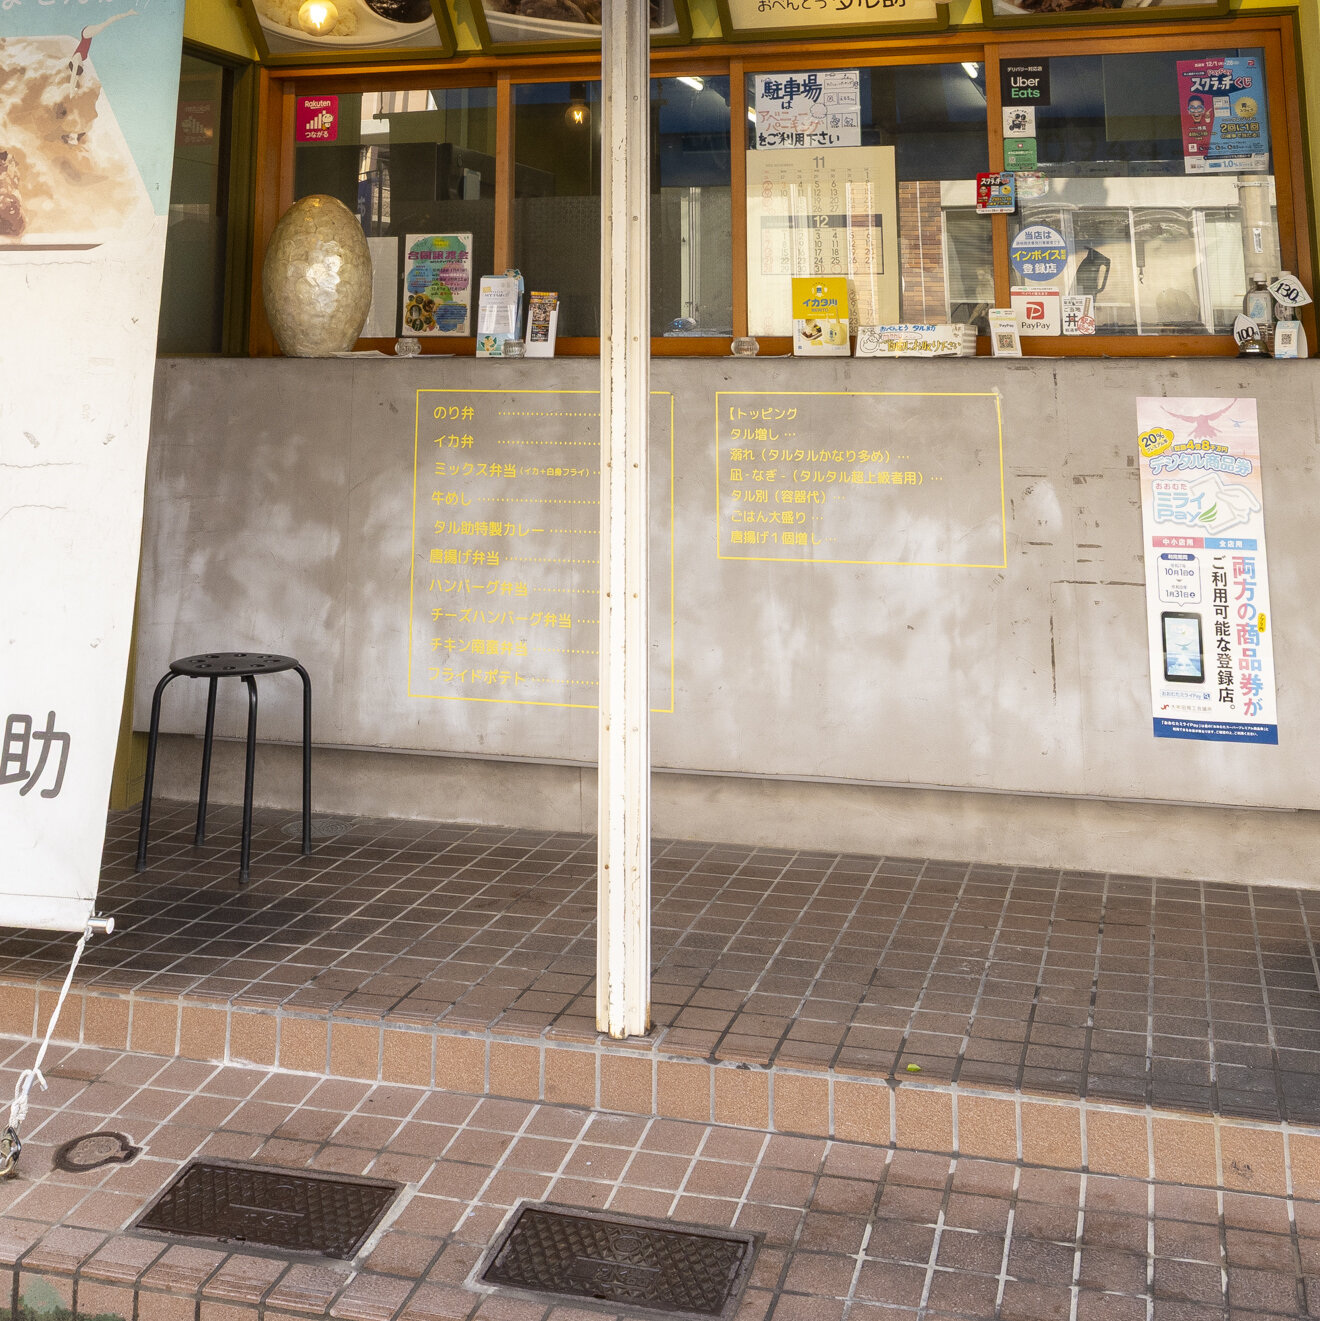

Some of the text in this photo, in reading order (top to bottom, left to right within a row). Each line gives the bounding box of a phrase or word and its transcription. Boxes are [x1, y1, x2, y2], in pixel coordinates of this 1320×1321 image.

[761, 73, 822, 102] 駐車場
[1010, 77, 1040, 87] Uber
[1190, 76, 1253, 92] スクラッチ くじ
[1011, 88, 1041, 99] Eats
[304, 100, 331, 109] Rakuten
[781, 100, 793, 110] は
[758, 130, 840, 147] をご利用下さい
[813, 215, 829, 228] 12
[1024, 230, 1052, 240] 当店は
[1012, 249, 1061, 261] インボイス
[1022, 263, 1057, 274] 登録店
[1021, 321, 1051, 330] PayPay
[433, 405, 475, 421] のり弁
[433, 433, 475, 449] イカ弁
[1149, 453, 1252, 477] デジタル商品券
[1155, 482, 1188, 491] おおむた
[431, 490, 473, 507] 牛めし
[1157, 491, 1206, 510] ミライ
[1157, 508, 1202, 523] Pay
[433, 520, 545, 537] タル助特製カレー
[429, 548, 500, 566] 唐揚げ弁当
[429, 578, 528, 597] ハンバーグ弁当
[431, 607, 572, 629] チーズハンバーグ弁当
[1211, 554, 1235, 710] ご利用可能な登録店。
[1231, 556, 1264, 717] 両方の商品券が
[429, 637, 528, 657] チキン南蛮弁当
[428, 666, 527, 687] フライドポテト
